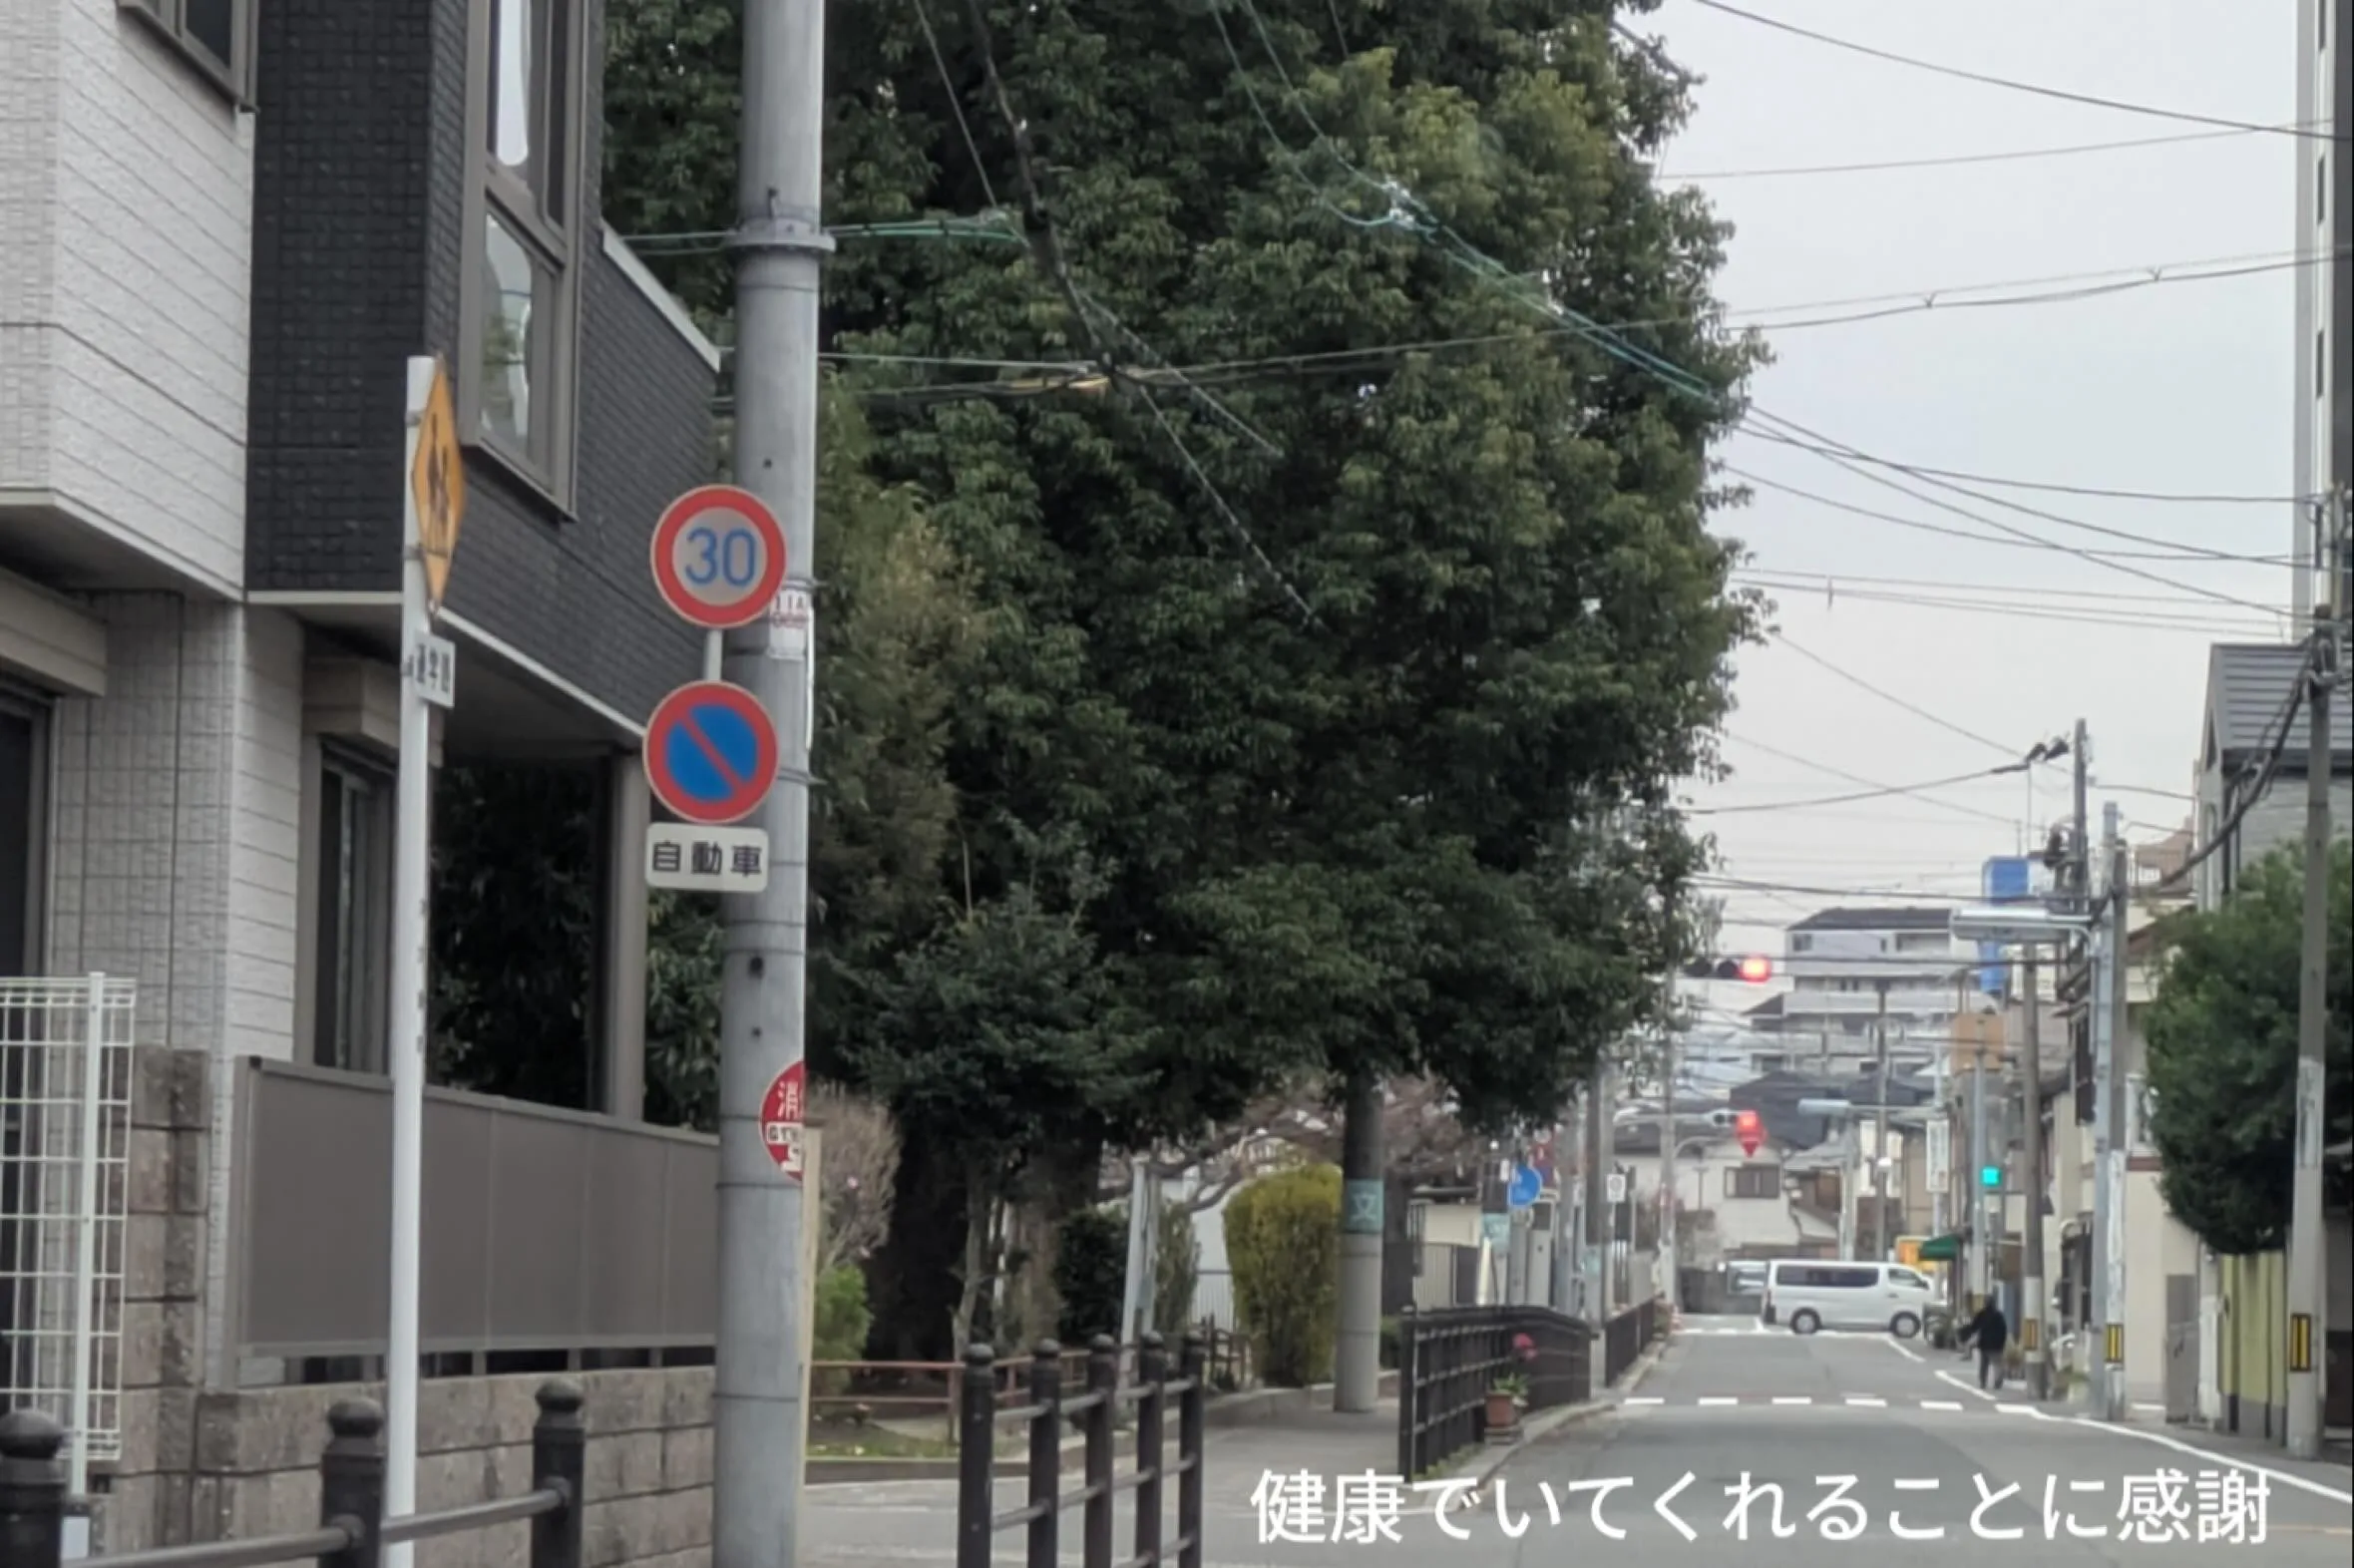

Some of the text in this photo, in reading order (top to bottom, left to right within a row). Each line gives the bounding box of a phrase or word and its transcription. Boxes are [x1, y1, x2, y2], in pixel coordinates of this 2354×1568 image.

[684, 529, 755, 587] 30
[652, 840, 761, 877] 自動車
[777, 1081, 804, 1119] 消
